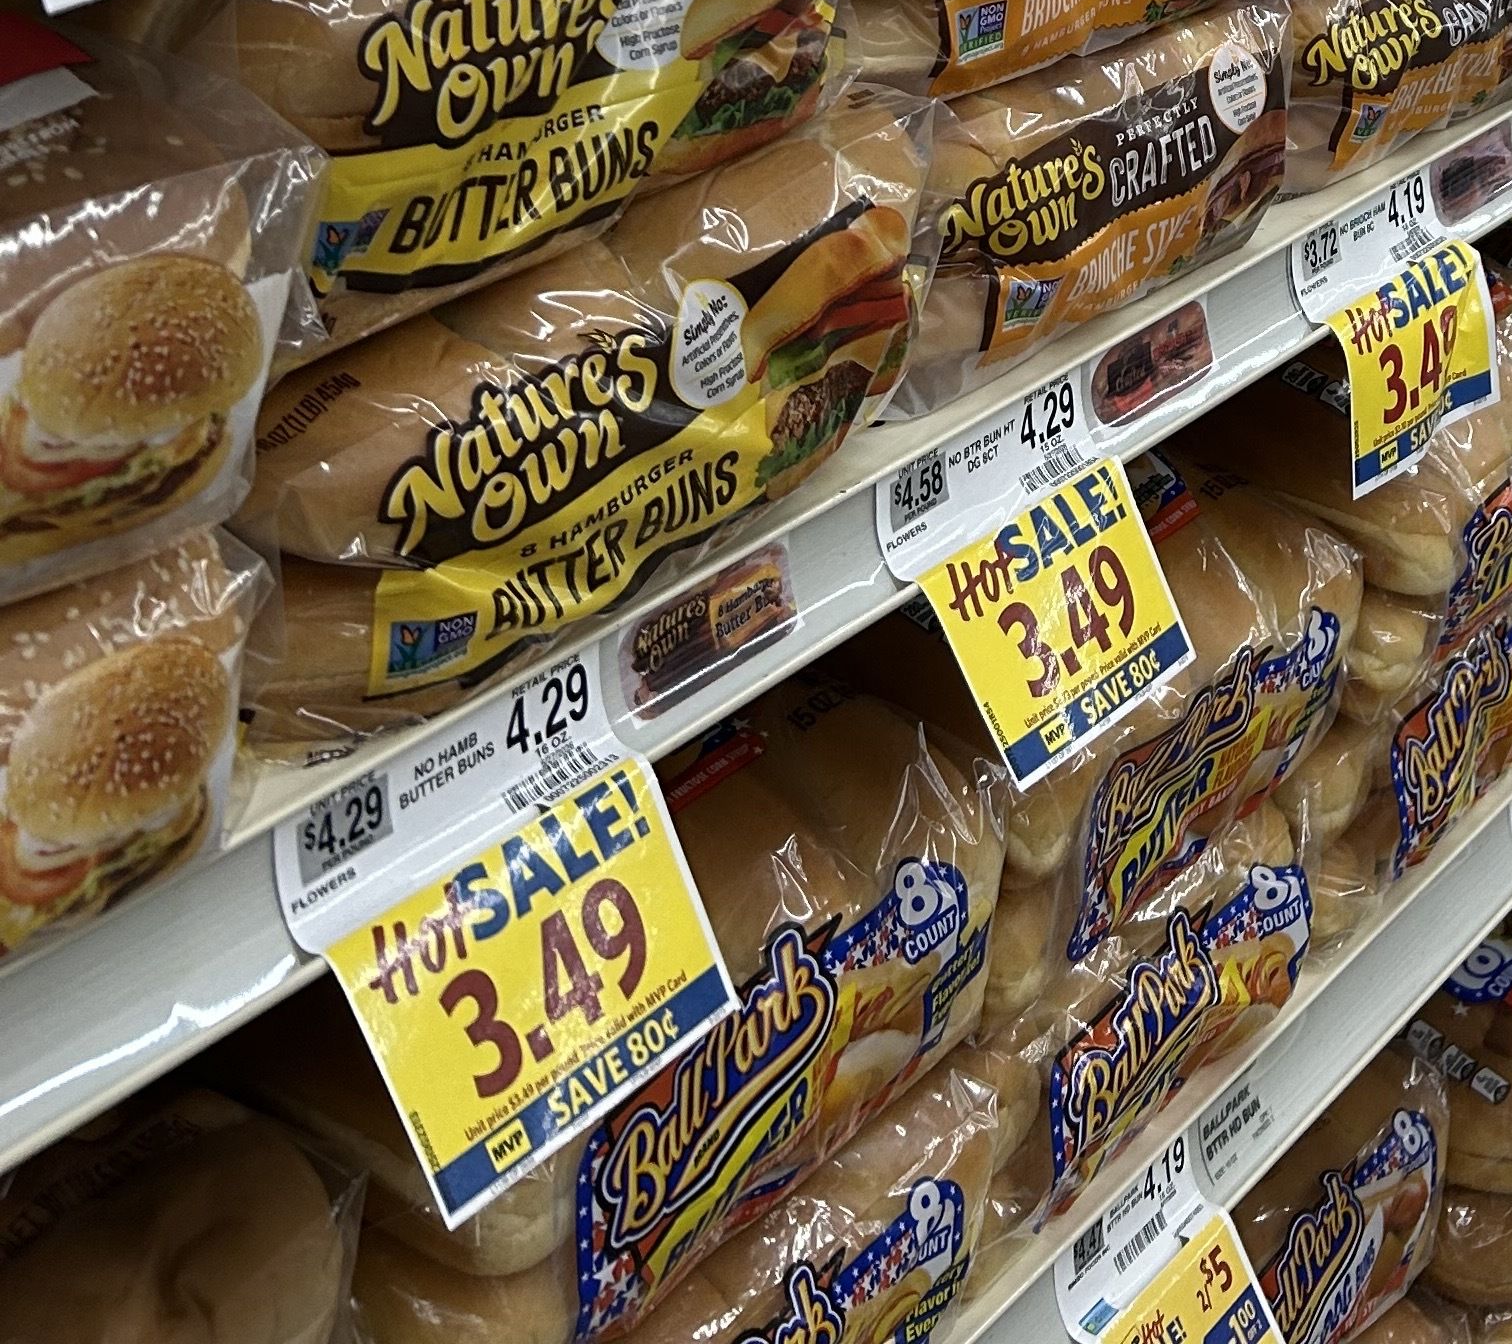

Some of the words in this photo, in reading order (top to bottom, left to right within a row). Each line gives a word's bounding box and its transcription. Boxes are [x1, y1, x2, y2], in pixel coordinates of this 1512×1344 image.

[438, 40, 577, 139] Own
[390, 160, 539, 254] BUTTER
[548, 121, 660, 208] BUNS
[939, 141, 1105, 252] Nature's
[1110, 115, 1217, 207] CRAFTED
[1387, 174, 1425, 229] 4.19
[989, 197, 1077, 256] Own
[1303, 229, 1338, 268] $3.72
[392, 333, 657, 558] Nature's
[1020, 381, 1075, 449] 4.29
[472, 413, 627, 544] Own
[521, 542, 537, 558] 8
[550, 448, 693, 551] HAMBURGER
[893, 462, 945, 512] $4.58
[486, 522, 628, 642] BUTTER
[635, 451, 739, 549] BUNS
[886, 522, 929, 552] FLOWERS
[949, 537, 1013, 622] Hot
[998, 466, 1127, 583] SALE!
[438, 616, 475, 631] NON
[438, 625, 474, 644] GMO
[997, 545, 1136, 699] 3.49
[506, 664, 589, 755] 4.29
[510, 674, 545, 699] RETAIL
[546, 654, 581, 681] PRICE
[1045, 723, 1065, 747] MVP
[1080, 672, 1128, 726] SAVE
[1130, 649, 1161, 693] 80¢
[399, 768, 456, 809] BUTTER
[457, 741, 495, 778] BUNS
[413, 759, 435, 779] NO
[437, 732, 478, 769] HAMB
[304, 787, 384, 855] $4.29
[290, 867, 357, 912] FLOWERS
[896, 861, 939, 927] 8
[1250, 865, 1290, 911] 8
[1253, 898, 1302, 937] COUNT
[904, 910, 959, 962] COUNT
[439, 877, 648, 1099] 3.49
[491, 1130, 524, 1162] MVP
[547, 1045, 627, 1127] SAVE
[629, 1010, 680, 1070] 80¢
[612, 1054, 710, 1238] Ball
[705, 930, 832, 1115] Park
[1202, 1083, 1250, 1139] BALLPARK
[1393, 1110, 1423, 1156] 8
[1143, 1136, 1186, 1201] 4.19
